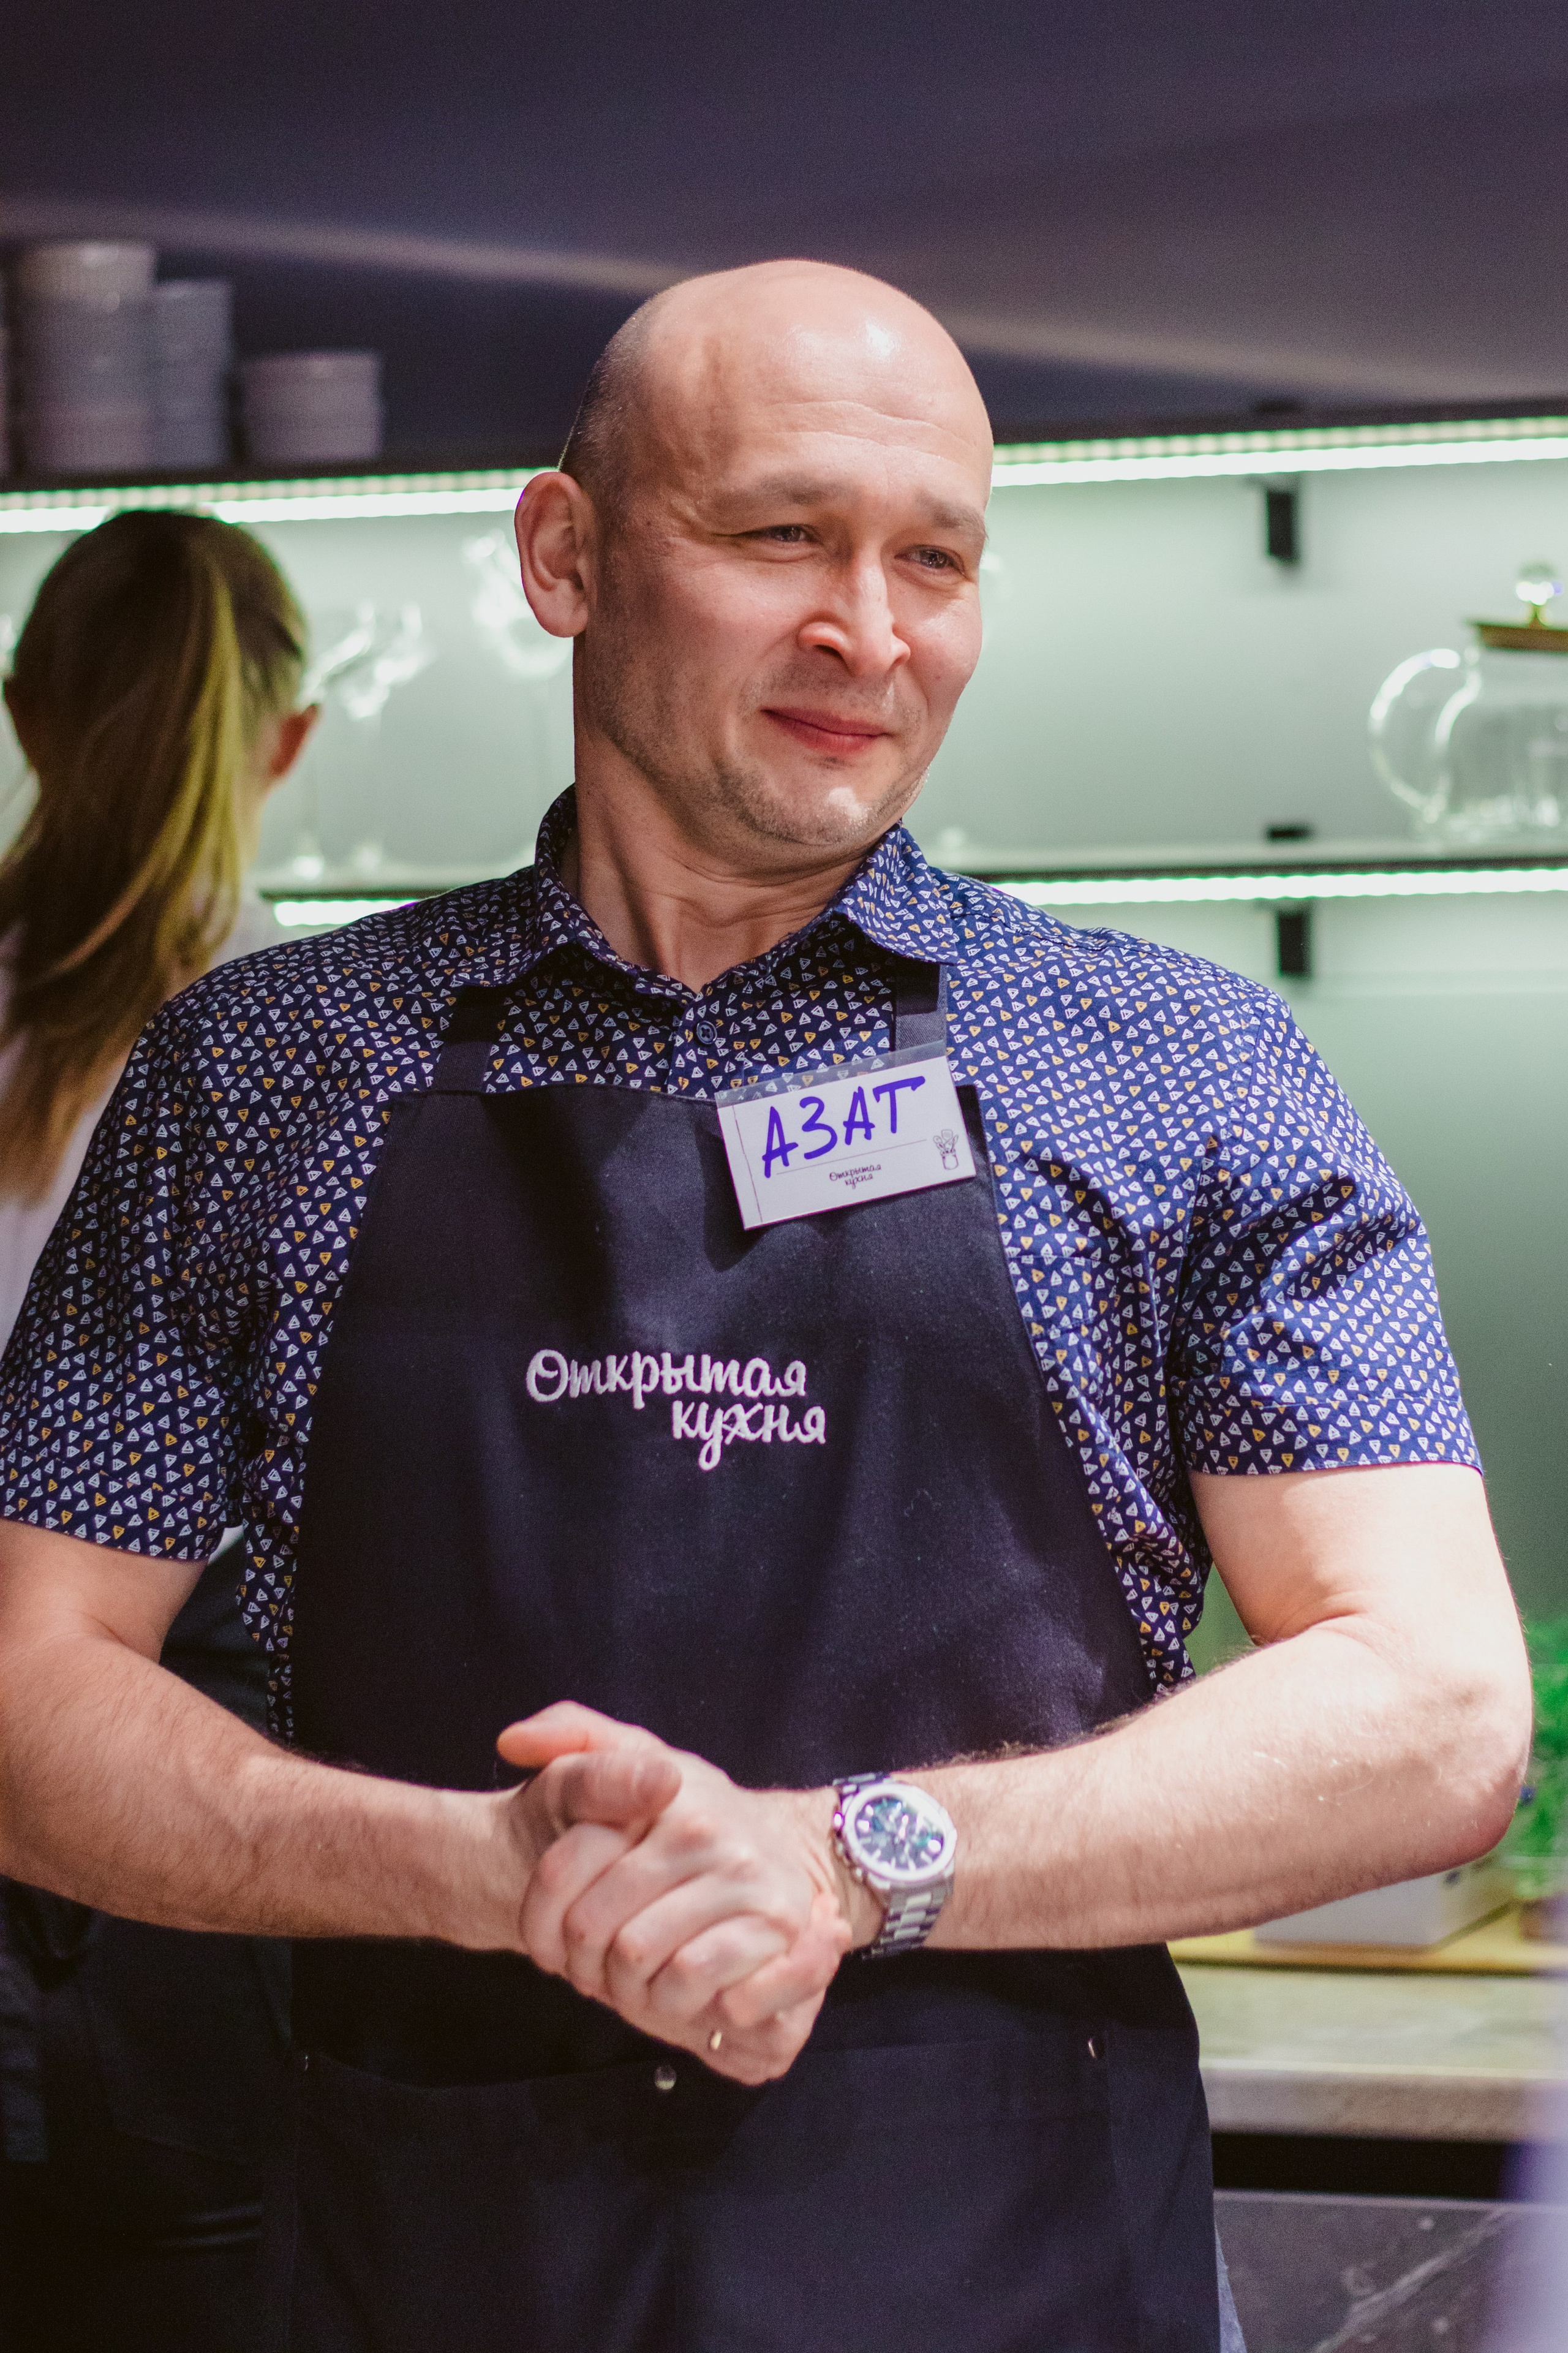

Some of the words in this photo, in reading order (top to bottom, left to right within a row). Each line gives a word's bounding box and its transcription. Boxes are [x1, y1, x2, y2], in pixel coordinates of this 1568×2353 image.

[762, 1075, 926, 1179] АЗАТ
[829, 1164, 881, 1181] Открытая
[844, 1173, 873, 1190] кухня
[526, 1348, 808, 1410] Открытая
[671, 1400, 827, 1471] кухня
